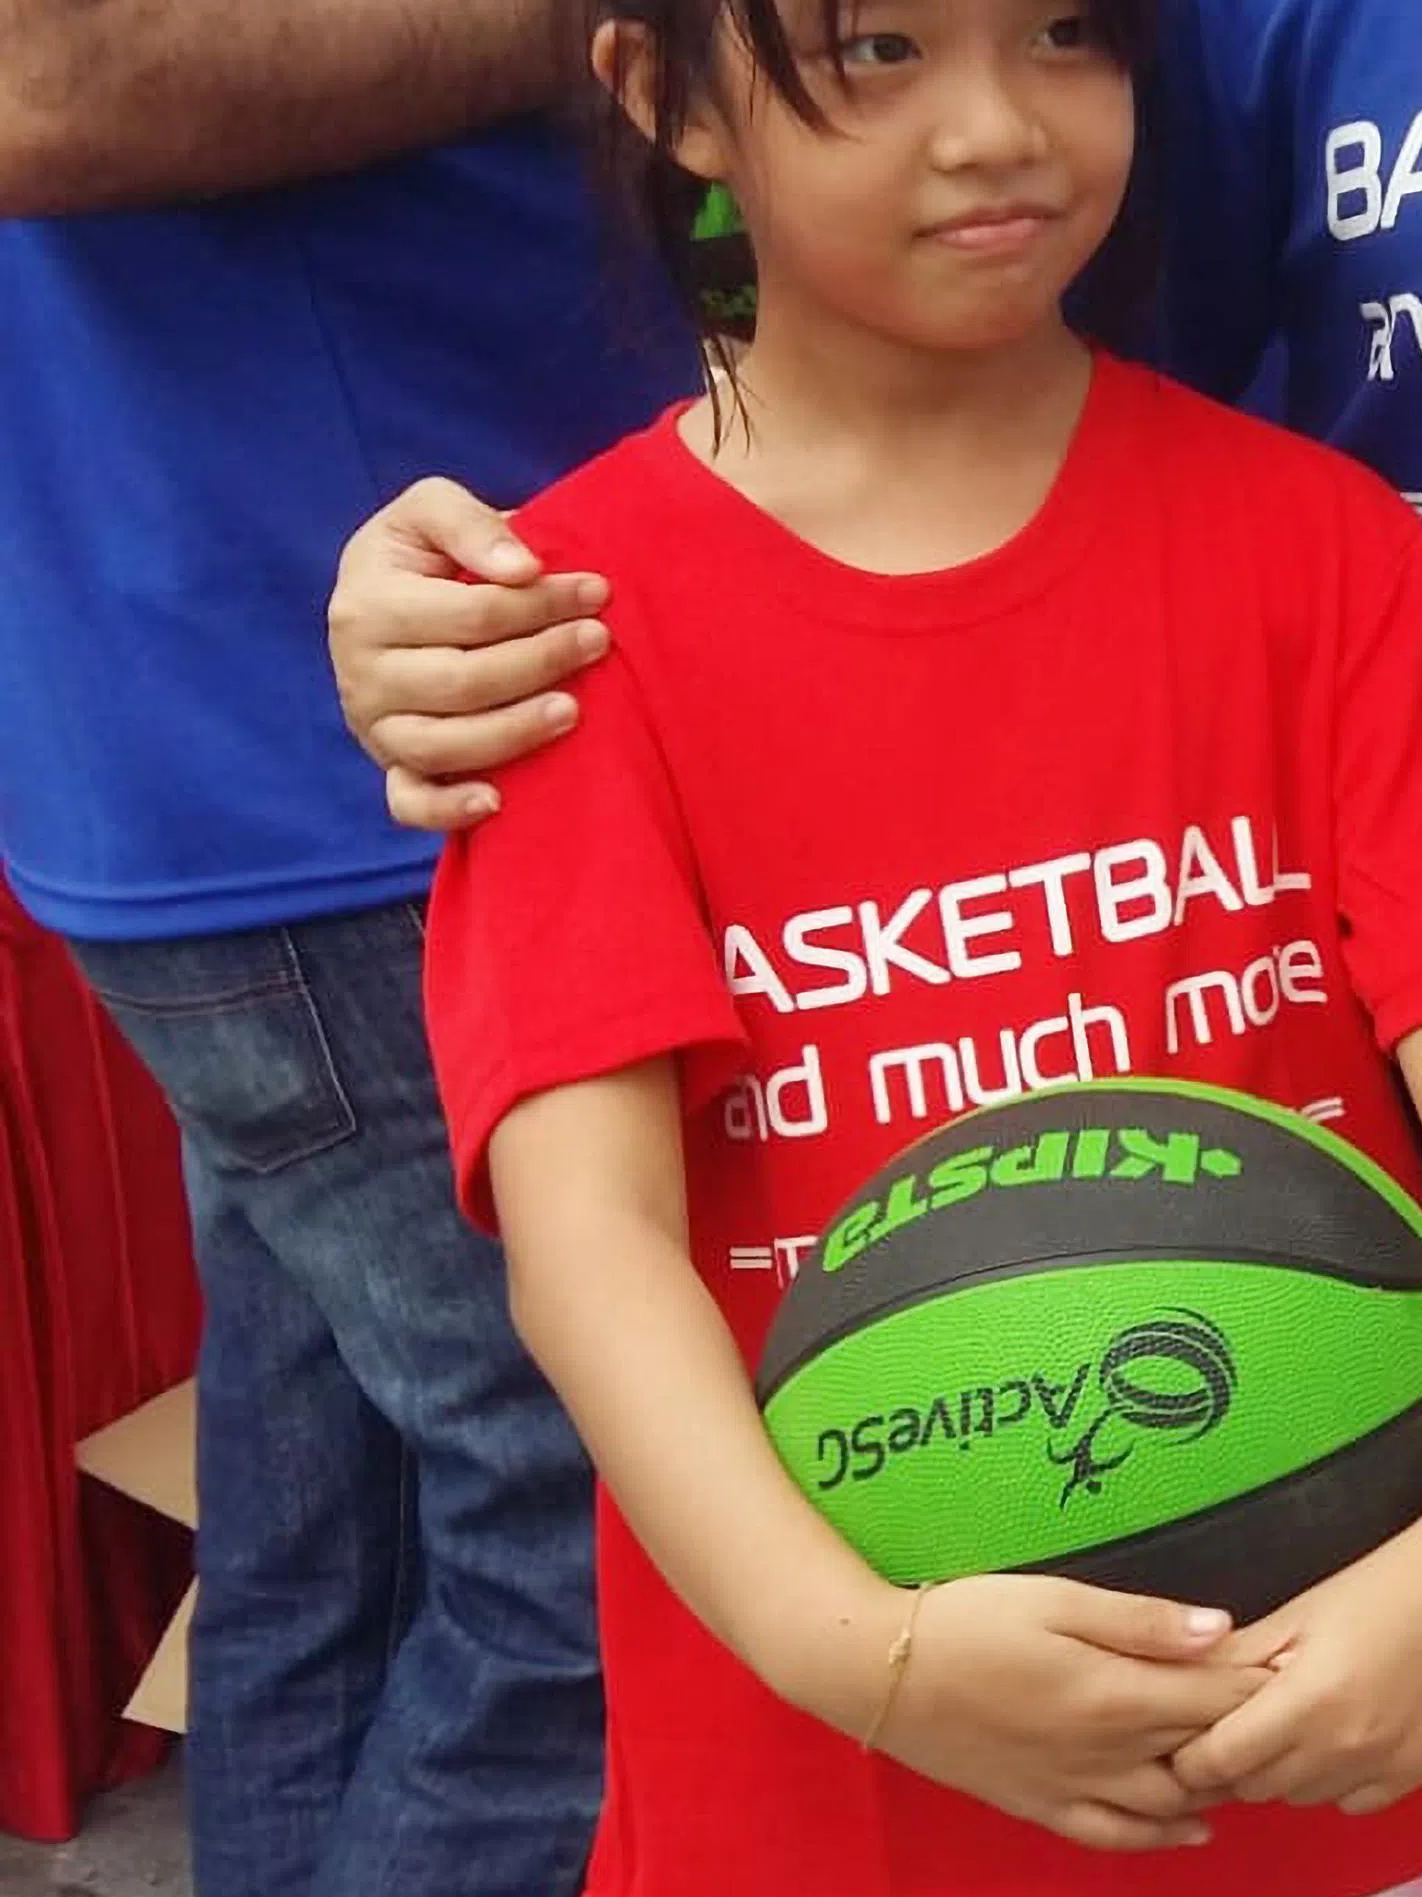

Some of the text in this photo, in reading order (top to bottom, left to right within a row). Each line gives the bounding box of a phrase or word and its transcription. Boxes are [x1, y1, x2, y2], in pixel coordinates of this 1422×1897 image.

[869, 992, 1131, 1126] much
[1165, 939, 1328, 1054] moe
[816, 1362, 1092, 1491] ActiveSG
